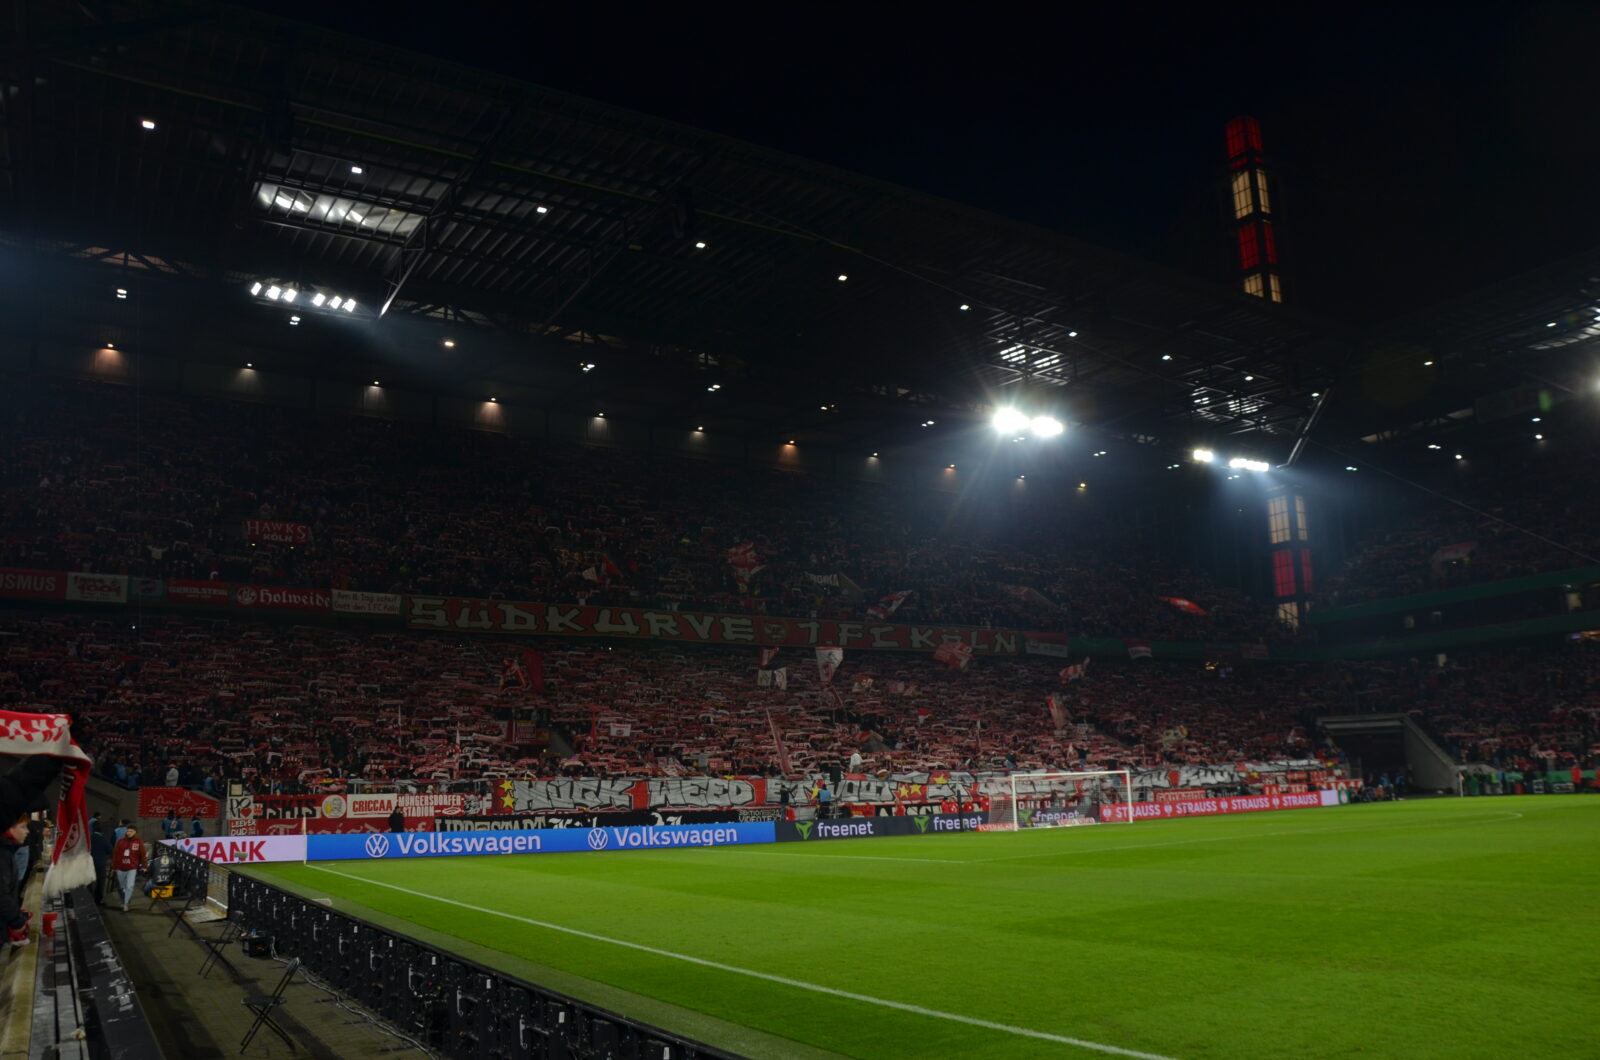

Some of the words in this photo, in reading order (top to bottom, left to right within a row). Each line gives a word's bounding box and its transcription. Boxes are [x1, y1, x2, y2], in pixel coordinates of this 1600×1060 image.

[247, 520, 307, 539] HAWKS
[259, 588, 331, 608] Holweide
[409, 597, 756, 641] SÜDKURVE
[352, 800, 393, 813] CRICCAA
[1175, 801, 1217, 814] STRAUSS
[1231, 797, 1266, 810] STRAUSS
[1282, 793, 1319, 806] STRAUSS
[614, 827, 738, 847] Volkswagen
[817, 821, 875, 837] freenet
[197, 840, 267, 862] BANK
[396, 832, 541, 855] Volkswagen
